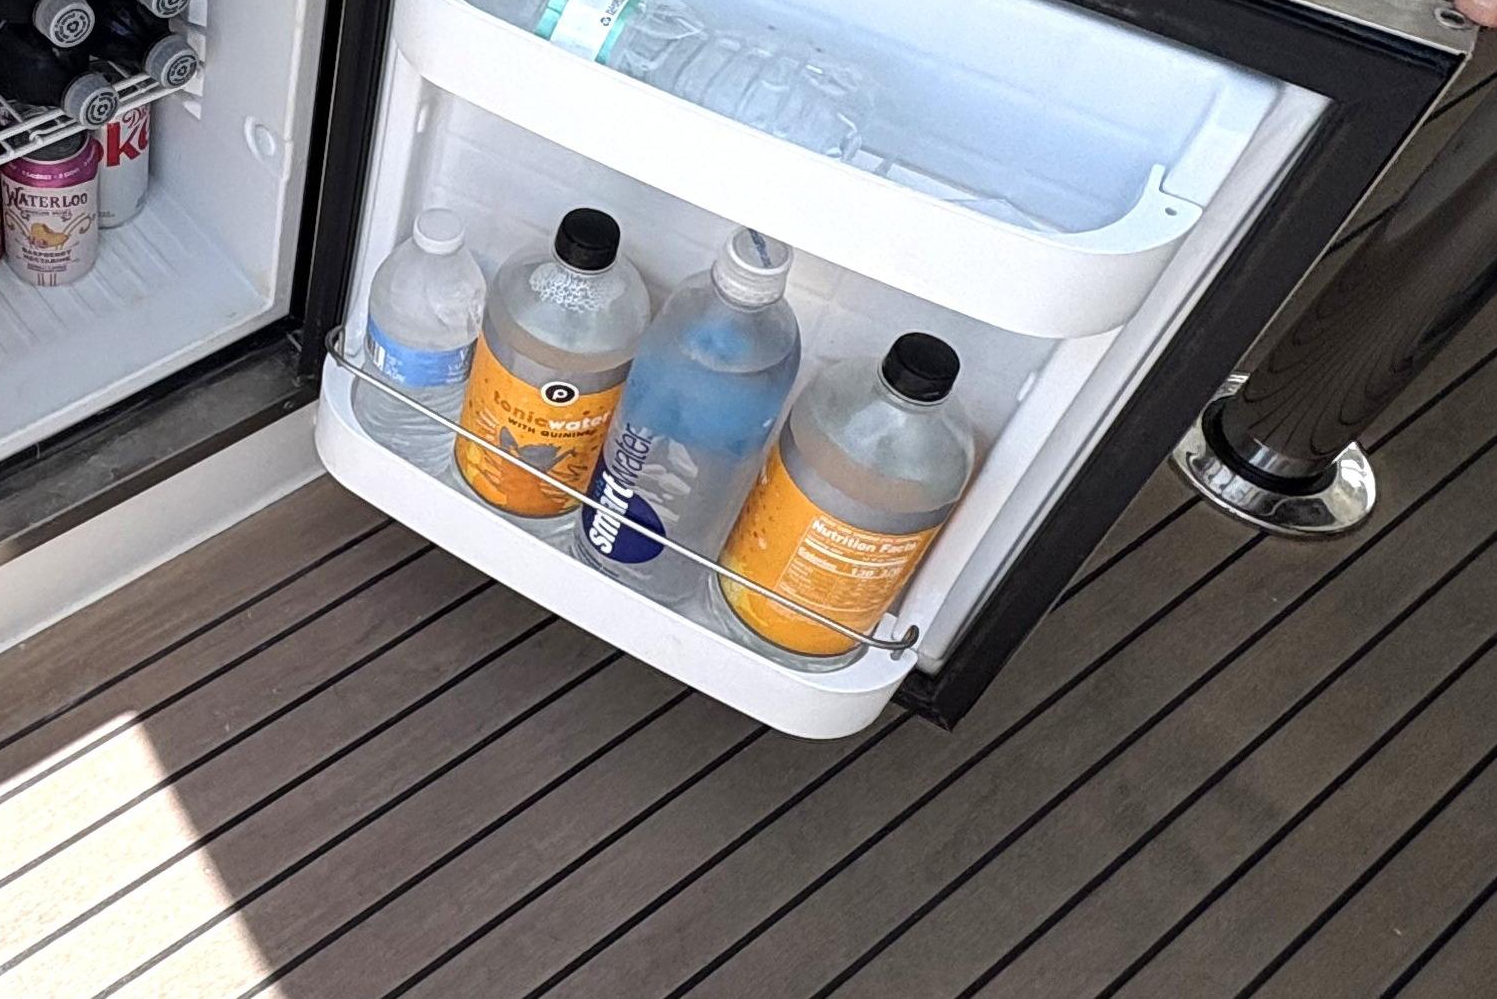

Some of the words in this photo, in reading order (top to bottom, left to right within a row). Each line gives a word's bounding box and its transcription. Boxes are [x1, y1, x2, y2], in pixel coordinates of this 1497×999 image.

[3, 180, 88, 211] WATERLOO
[507, 417, 536, 434] WITH
[812, 519, 876, 553] Nutrition
